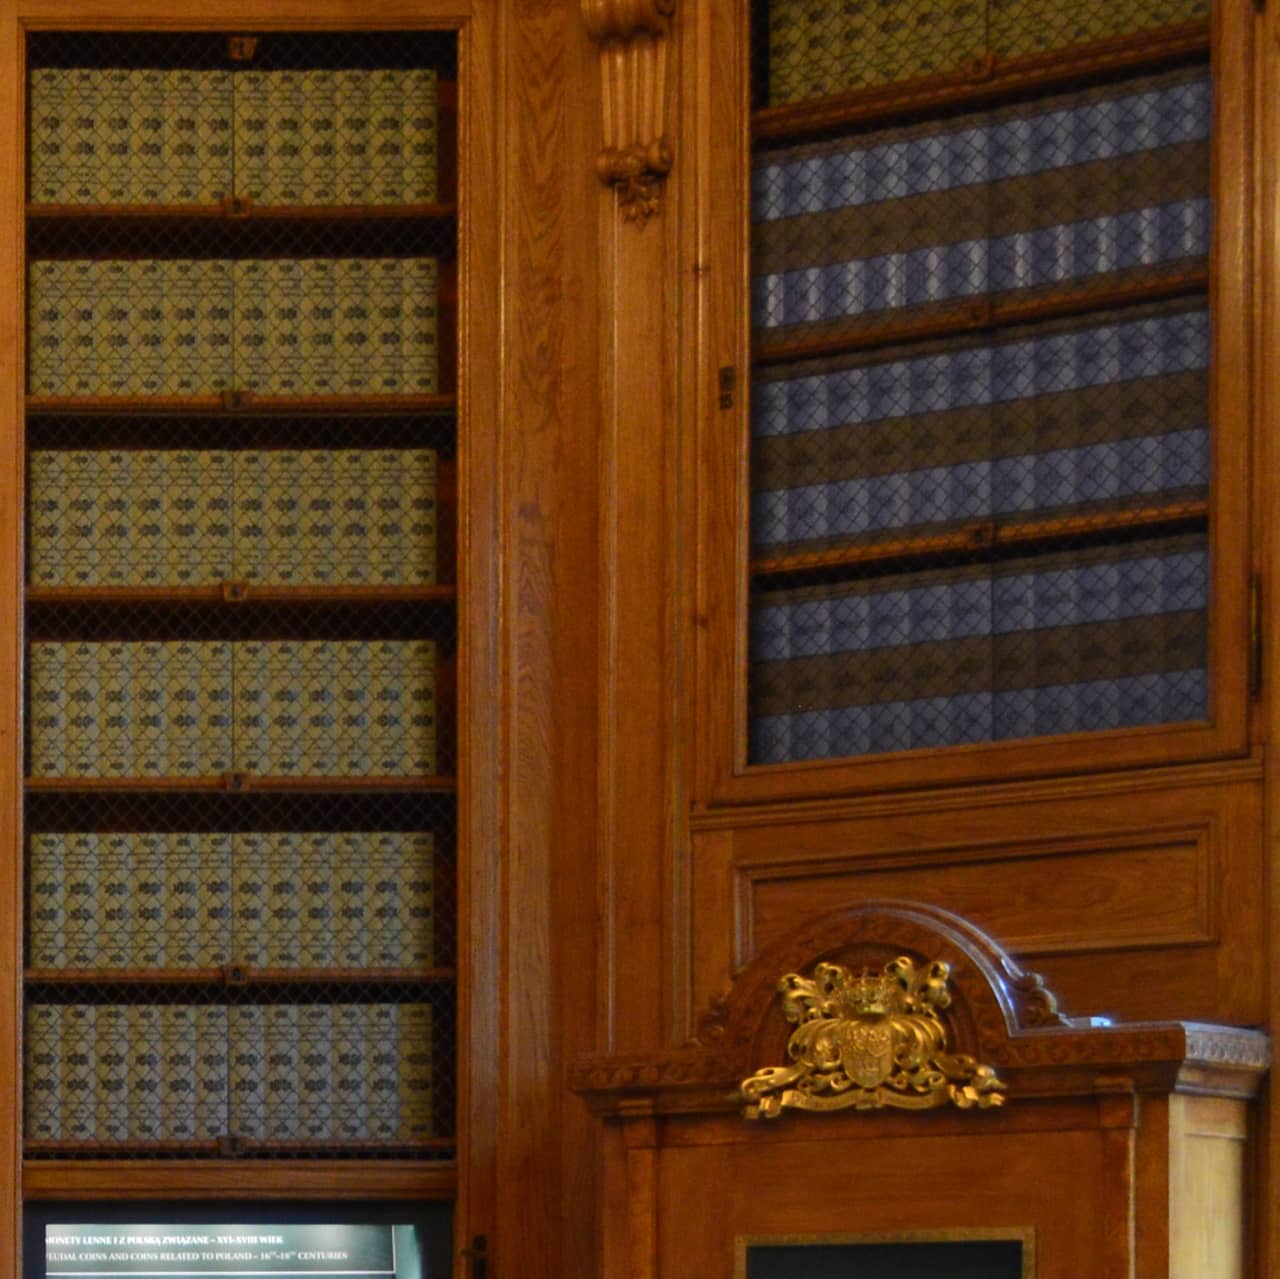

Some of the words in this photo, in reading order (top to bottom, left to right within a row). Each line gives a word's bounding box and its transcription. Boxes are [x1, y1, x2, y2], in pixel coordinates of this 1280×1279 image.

[78, 1252, 108, 1261] COINS
[109, 1252, 129, 1260] AND
[130, 1252, 158, 1260] COINS
[159, 1252, 200, 1260] RELATED
[201, 1252, 214, 1260] TO
[215, 1252, 253, 1260] POLAND
[297, 1250, 349, 1260] CENTURIES
